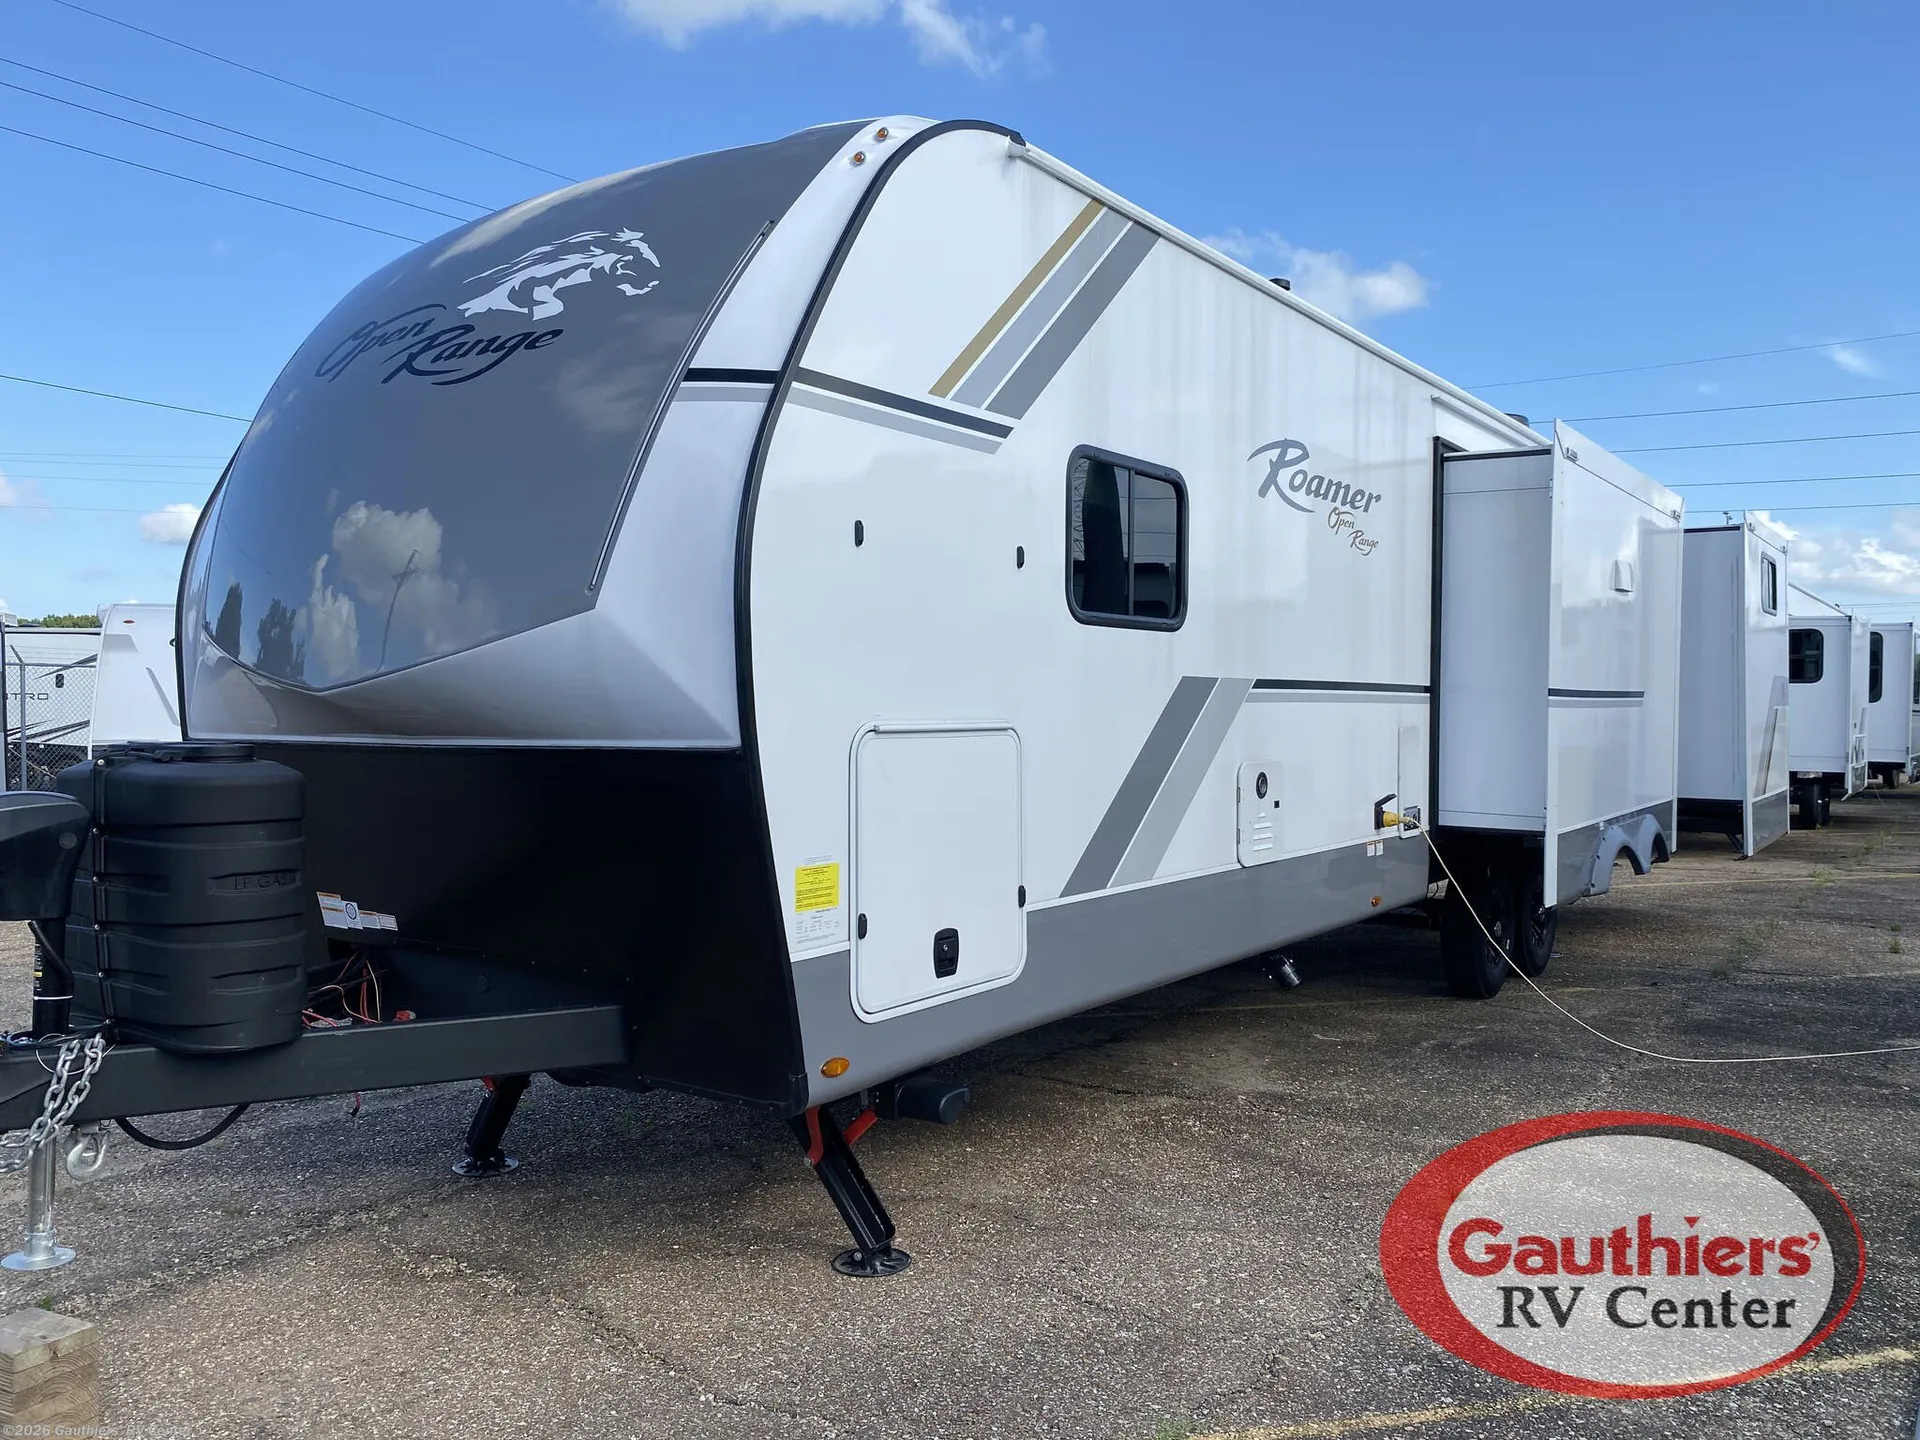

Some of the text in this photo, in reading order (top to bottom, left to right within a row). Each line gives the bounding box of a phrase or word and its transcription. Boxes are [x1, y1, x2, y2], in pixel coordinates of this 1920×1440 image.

[315, 303, 447, 383] Open
[380, 323, 564, 386] Range
[1246, 437, 1382, 514] Roamer
[1327, 506, 1356, 536] Open
[1347, 529, 1379, 557] Range
